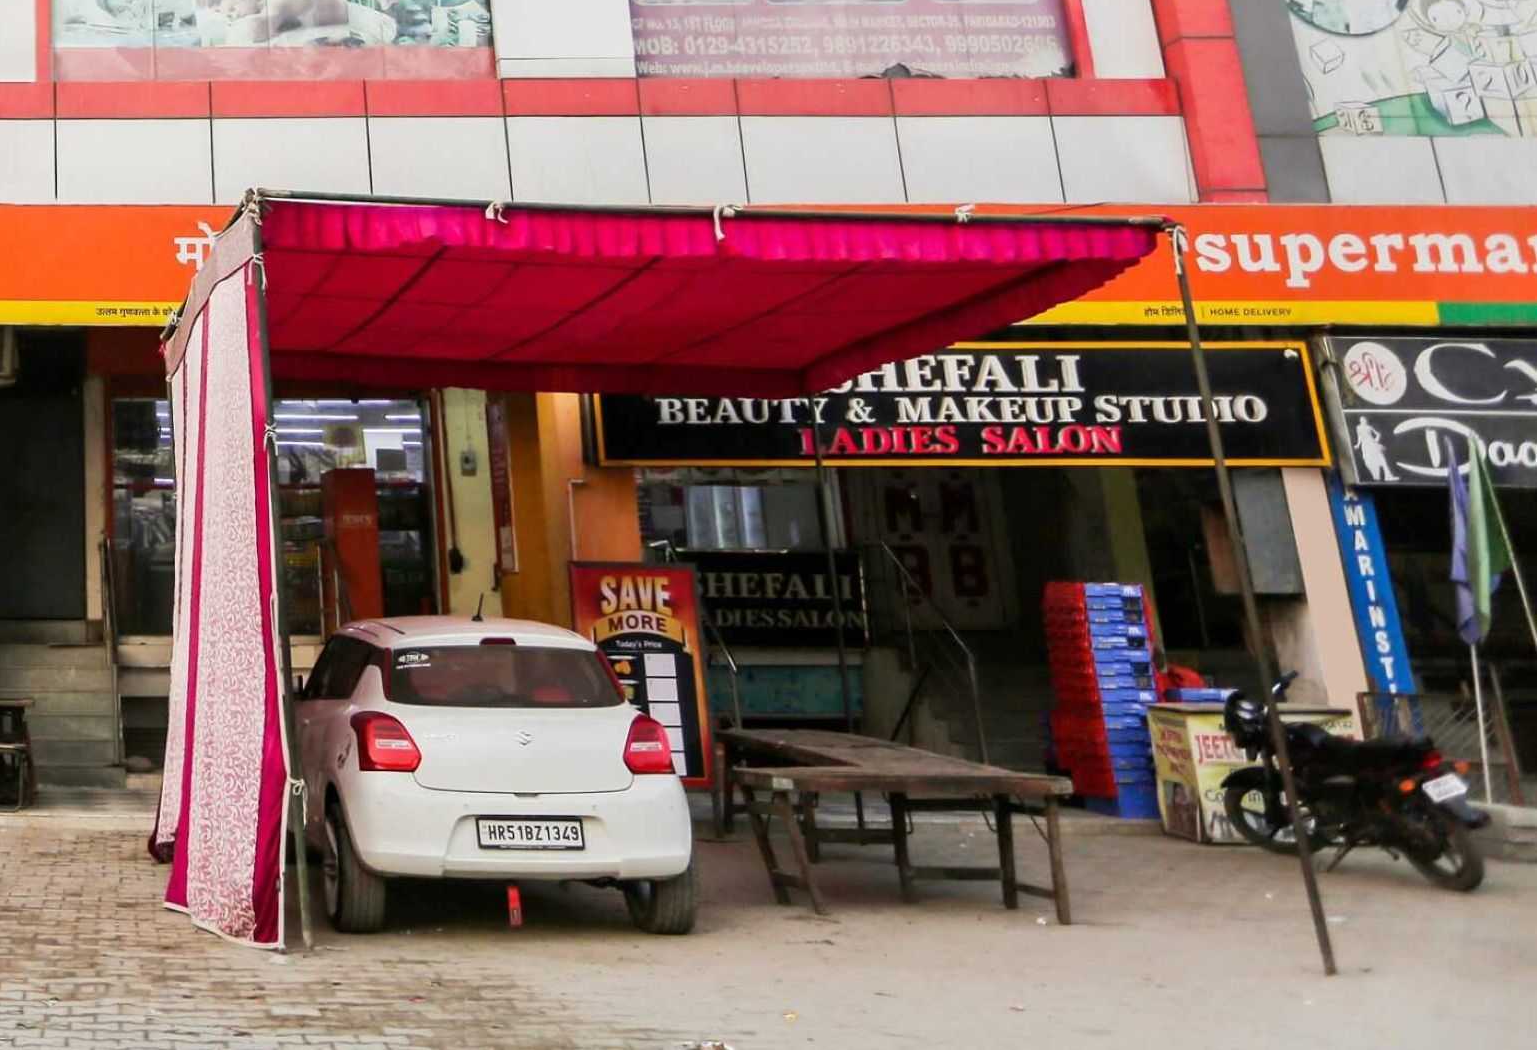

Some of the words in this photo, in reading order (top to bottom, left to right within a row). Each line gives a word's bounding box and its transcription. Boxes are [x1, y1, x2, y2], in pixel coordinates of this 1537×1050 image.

[1195, 231, 1537, 288] superma
[1210, 308, 1240, 316] HOME
[1243, 307, 1292, 316] DELIVERY
[657, 396, 826, 425] BEAUTY
[846, 397, 874, 424] &
[897, 396, 1092, 424] MAKEUP
[981, 426, 1122, 454] SALON
[600, 575, 672, 616] SAVE
[608, 613, 667, 633] MORE
[487, 823, 579, 842] HR51BZ1349
